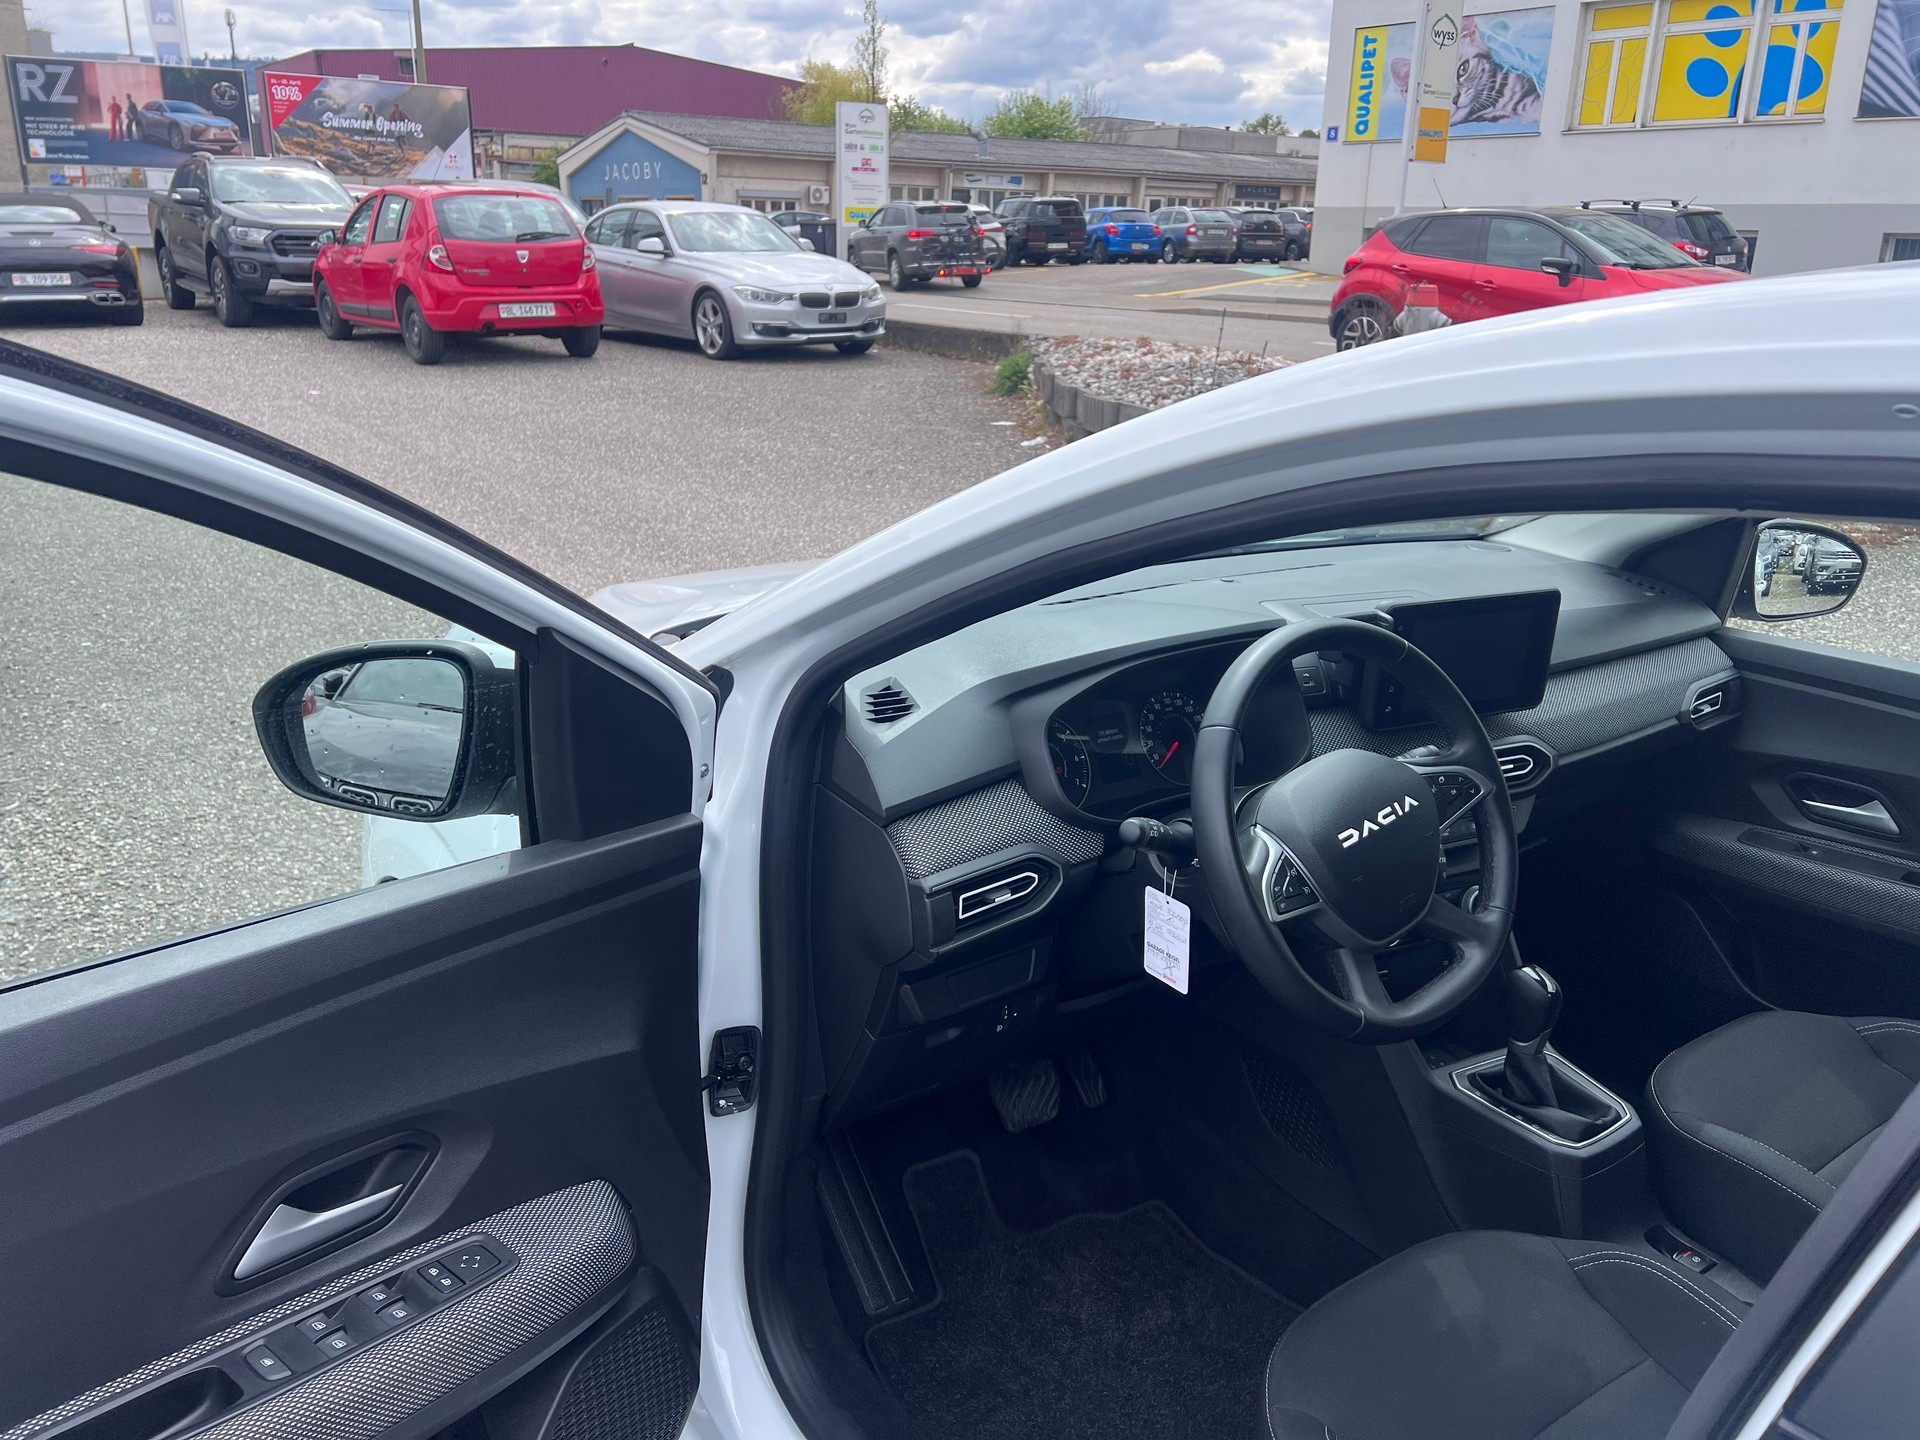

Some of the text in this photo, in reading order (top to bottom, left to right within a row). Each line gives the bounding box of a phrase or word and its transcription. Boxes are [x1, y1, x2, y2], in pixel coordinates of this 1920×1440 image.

[1433, 29, 1455, 49] wyss
[16, 62, 78, 103] RZ
[1354, 35, 1378, 135] QUALIPET
[271, 85, 302, 100] 10%
[322, 111, 424, 138] Summer Opening
[1330, 129, 1336, 138] 8
[604, 161, 662, 181] JACOBY
[506, 305, 549, 315] BL 146771
[1174, 698, 1182, 706] 130
[1185, 705, 1194, 713] 150
[1145, 725, 1152, 733] 50
[1337, 795, 1419, 848] DACIA
[1146, 941, 1165, 956] GARAGE
